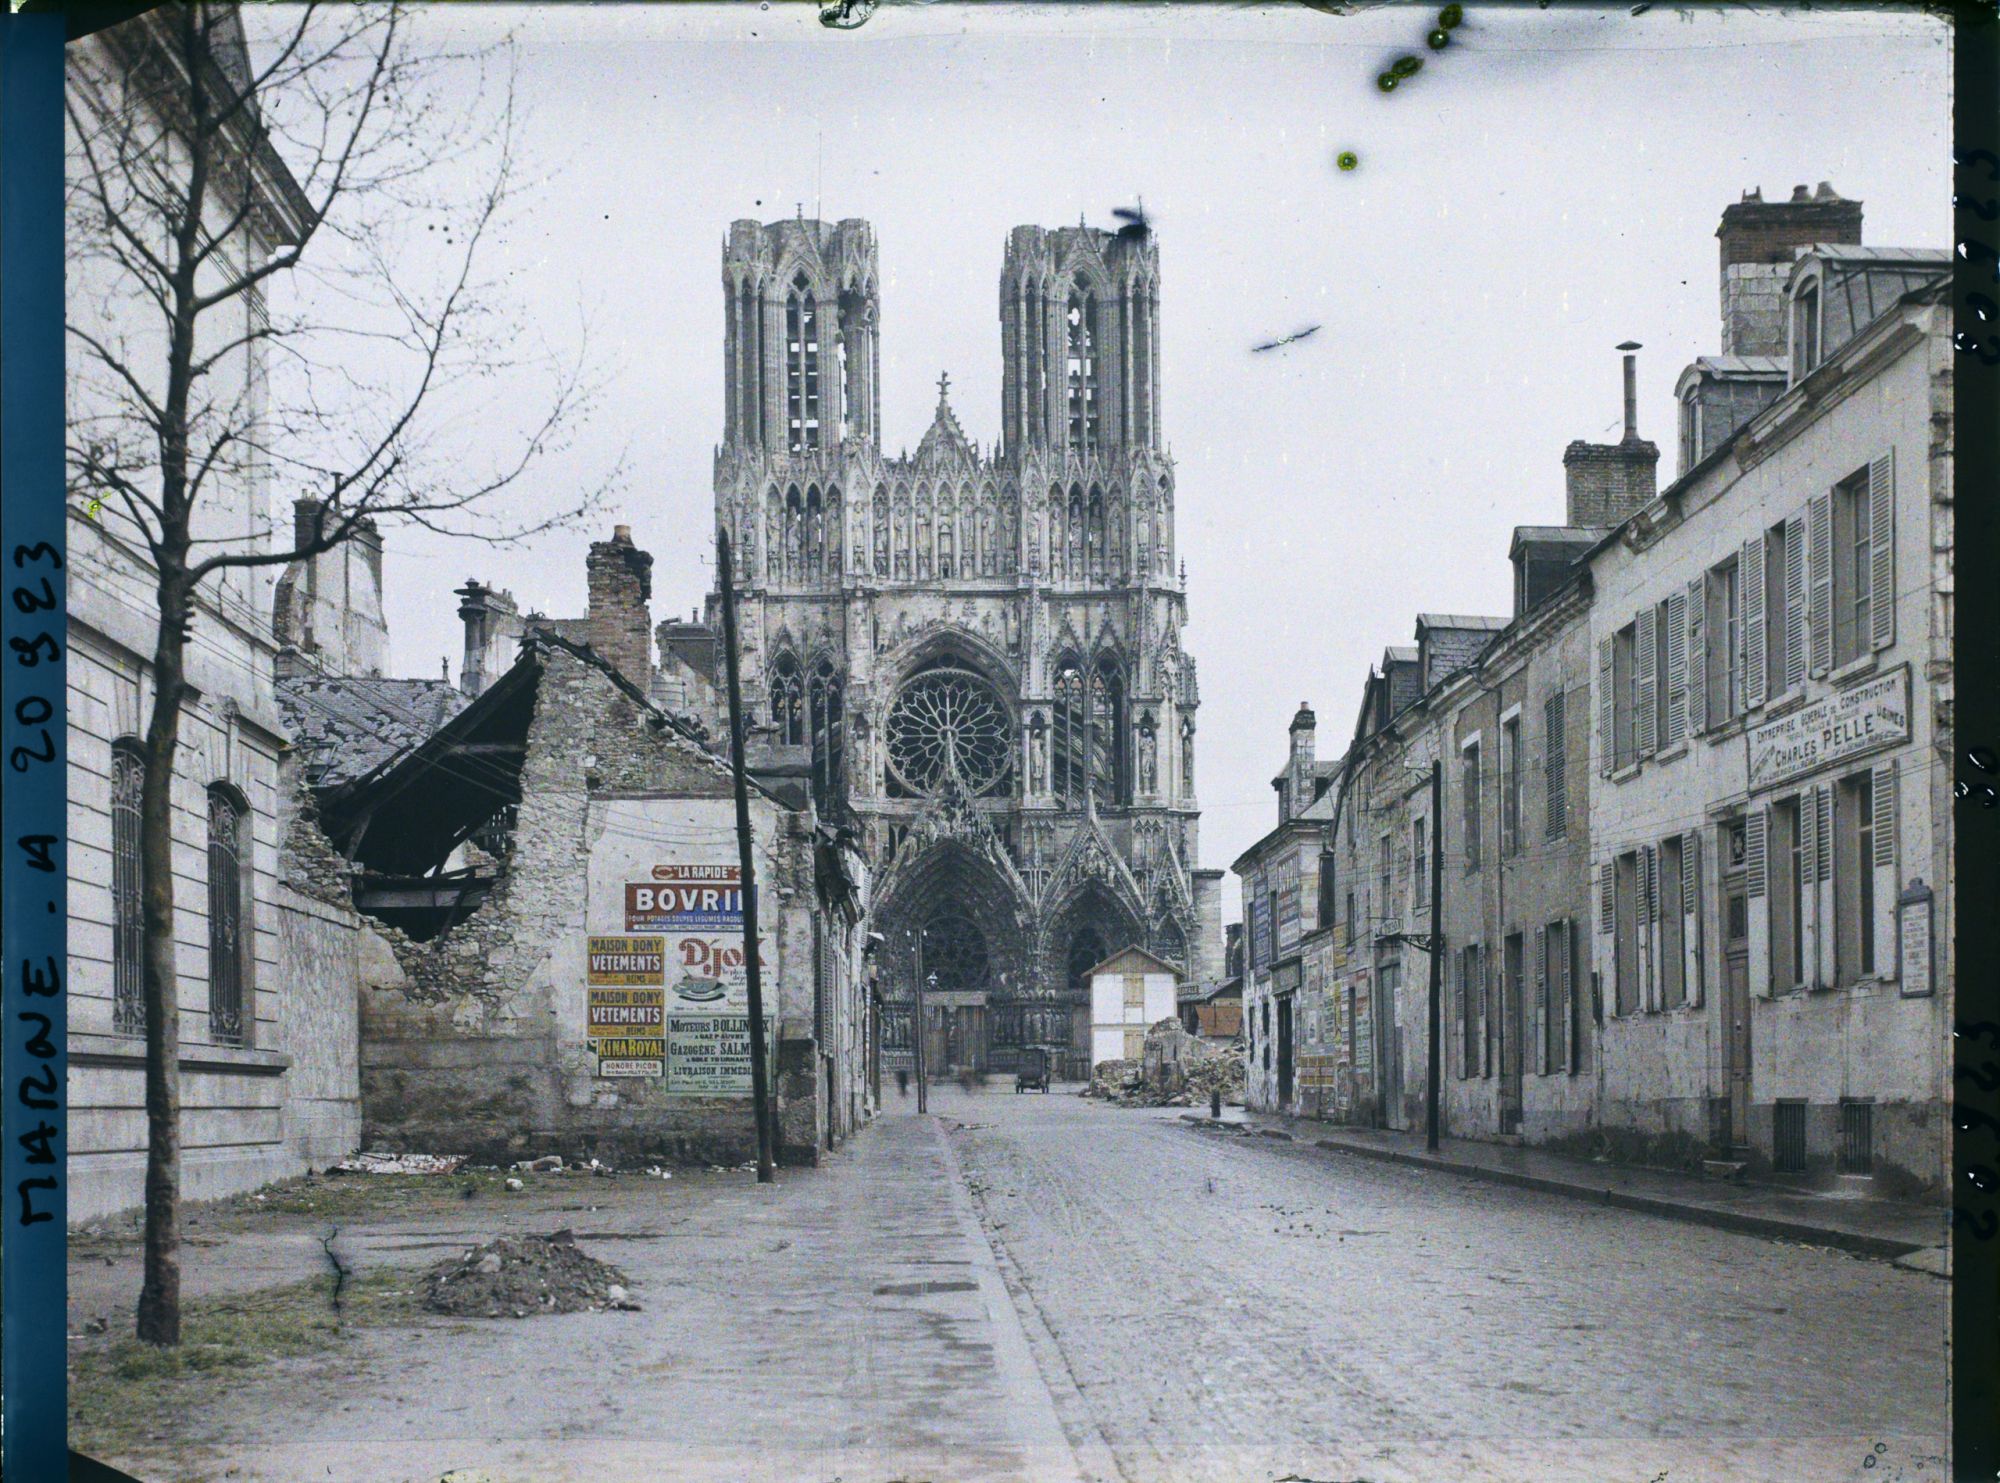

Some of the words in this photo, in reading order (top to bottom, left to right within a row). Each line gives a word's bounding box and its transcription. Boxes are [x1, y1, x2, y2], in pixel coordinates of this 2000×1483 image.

[1757, 718, 1796, 744] ENTREPRISE
[1840, 679, 1896, 710] CONSTRUCTION
[1876, 704, 1905, 728] USINES
[1775, 739, 1817, 767] CHARLES
[591, 940, 627, 952] MAISON
[633, 940, 661, 952] DONY
[627, 975, 645, 984] REIMS
[591, 992, 627, 1004] MAISON
[633, 992, 661, 1004] DONY
[627, 1027, 645, 1036] REIMS
[670, 1019, 711, 1032] MOTEURS
[713, 1019, 769, 1032] BOLLINX
[636, 1061, 657, 1069] PICON
[674, 1066, 716, 1075] LIVRAISON
[18, 957, 58, 1226] MARNE
